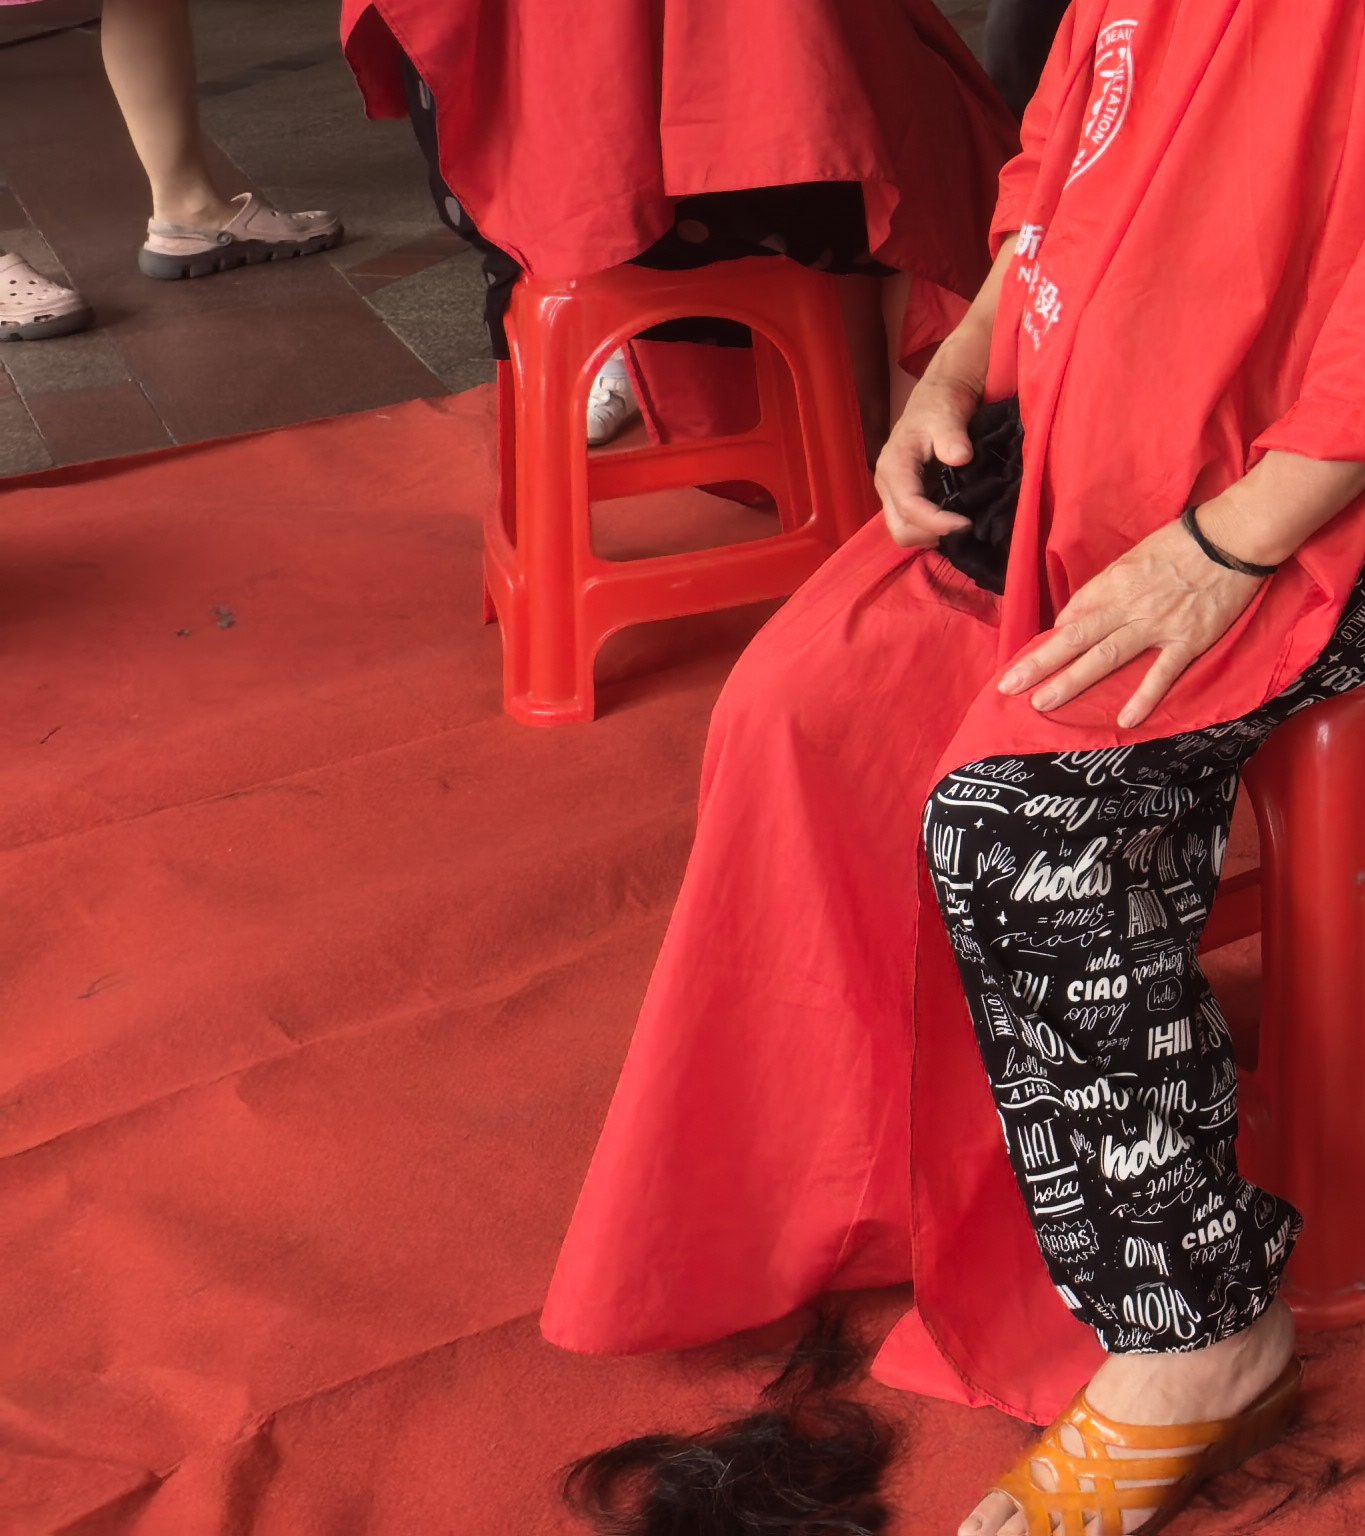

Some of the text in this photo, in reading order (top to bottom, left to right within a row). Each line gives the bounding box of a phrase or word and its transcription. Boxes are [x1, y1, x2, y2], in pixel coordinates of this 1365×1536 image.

[933, 822, 966, 875] HAI
[1010, 836, 1112, 903] hola
[1085, 947, 1124, 972] hola
[1067, 975, 1128, 1002] CIAO
[987, 998, 1015, 1036] HALLO
[1064, 1002, 1131, 1035] hello
[1017, 1118, 1060, 1168] HAI
[1034, 1179, 1079, 1204] hola
[1192, 1191, 1226, 1223] hola
[1181, 1209, 1237, 1250] CIAO
